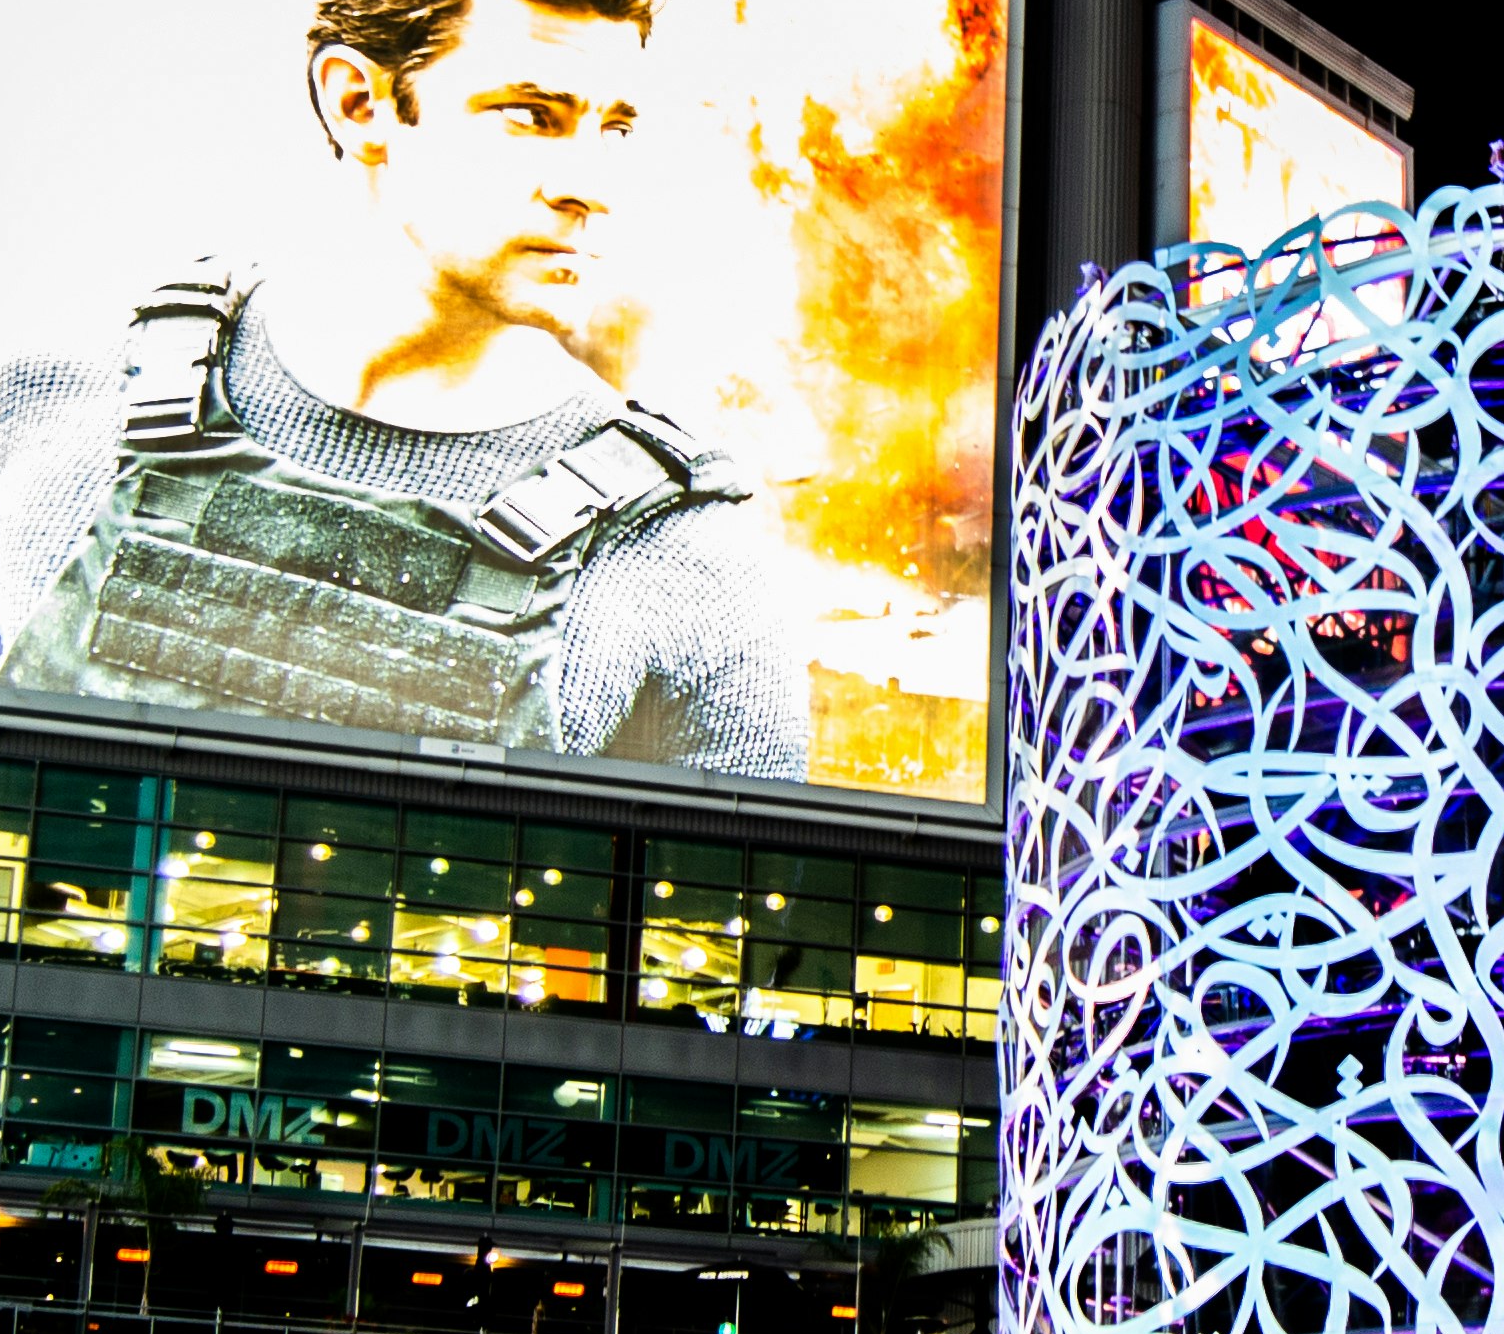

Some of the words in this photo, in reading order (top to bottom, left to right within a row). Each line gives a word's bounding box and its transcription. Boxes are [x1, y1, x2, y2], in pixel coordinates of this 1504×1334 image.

[181, 1087, 328, 1145] DMZ
[427, 1112, 568, 1165] DMZ
[664, 1132, 800, 1185] DMZ
